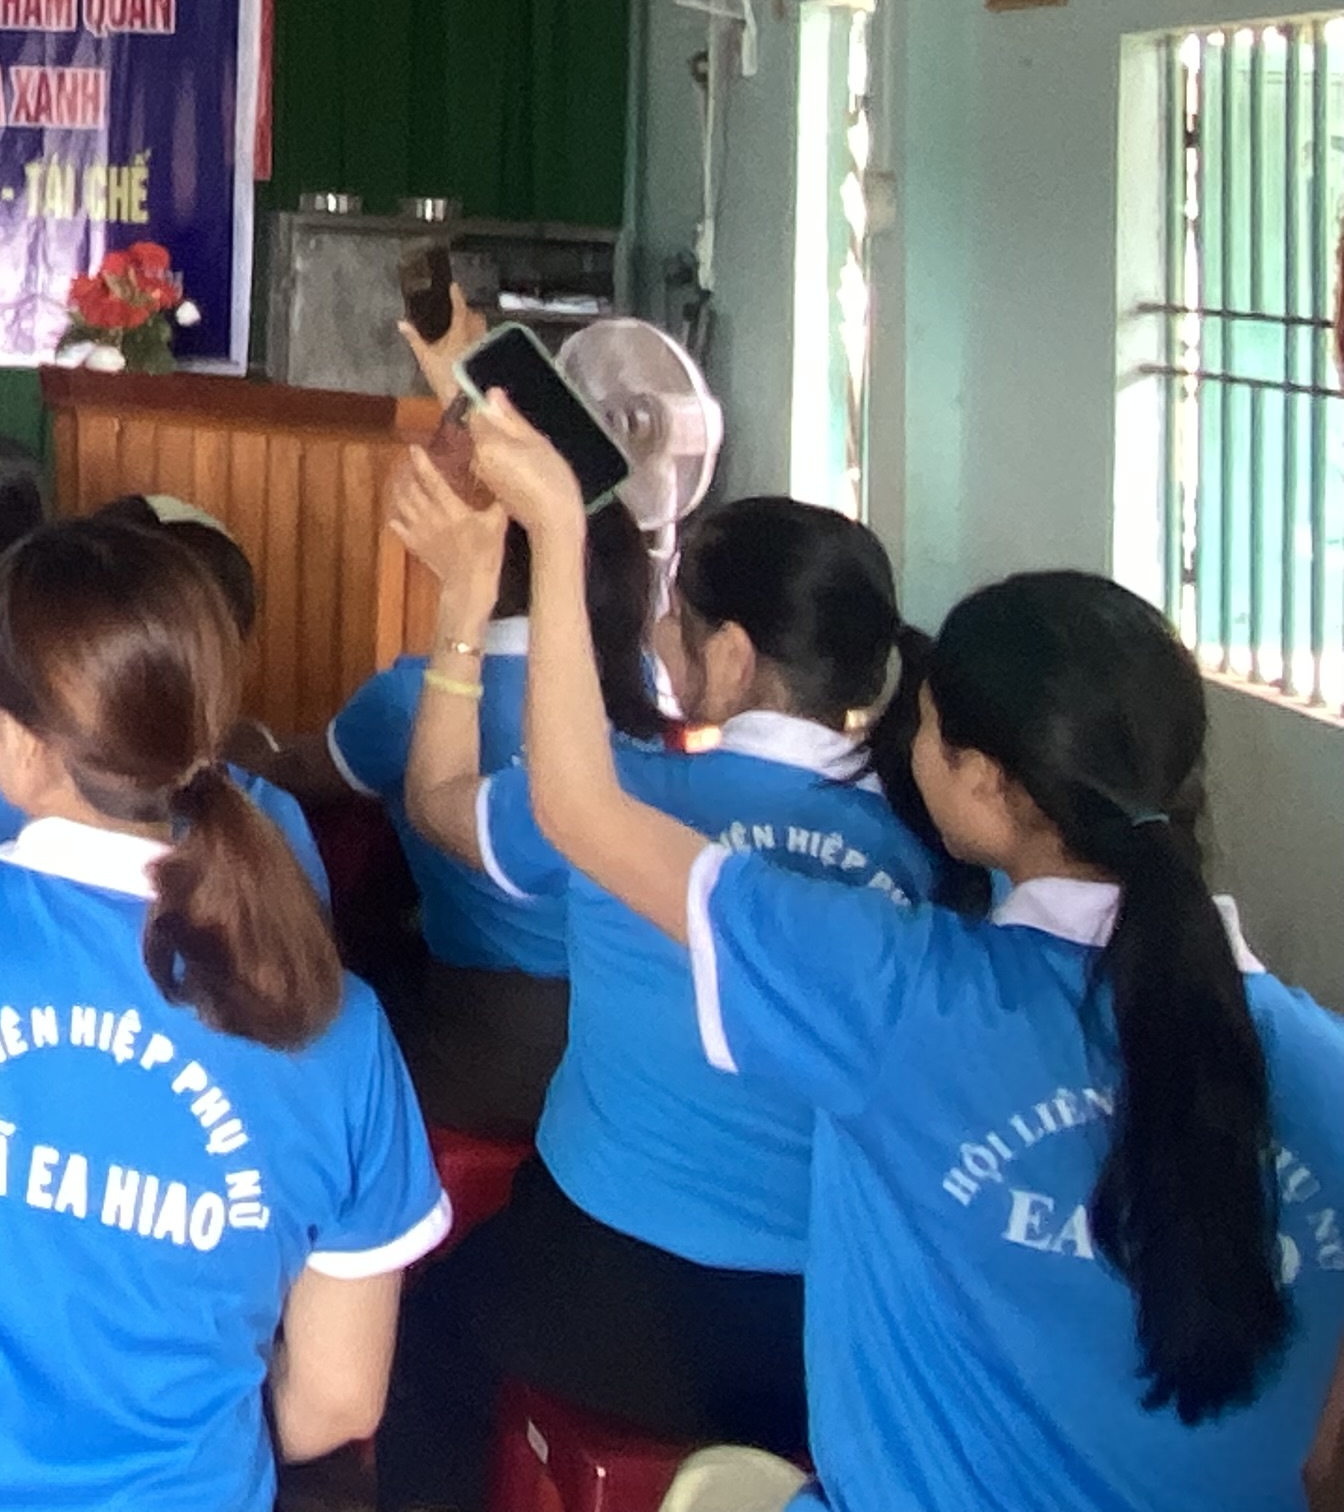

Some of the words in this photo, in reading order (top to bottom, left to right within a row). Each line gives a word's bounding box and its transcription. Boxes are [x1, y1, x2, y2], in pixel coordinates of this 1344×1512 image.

[8, 65, 107, 131] XANH
[24, 152, 76, 222] TÁI
[83, 148, 152, 225] CHẾ
[70, 1005, 174, 1070] HIỆP
[171, 1060, 249, 1155] PHỤ
[26, 1144, 88, 1219] EA
[101, 1164, 225, 1251] HIAO
[942, 1131, 1014, 1206] HỘI
[1003, 1190, 1095, 1260] EA
